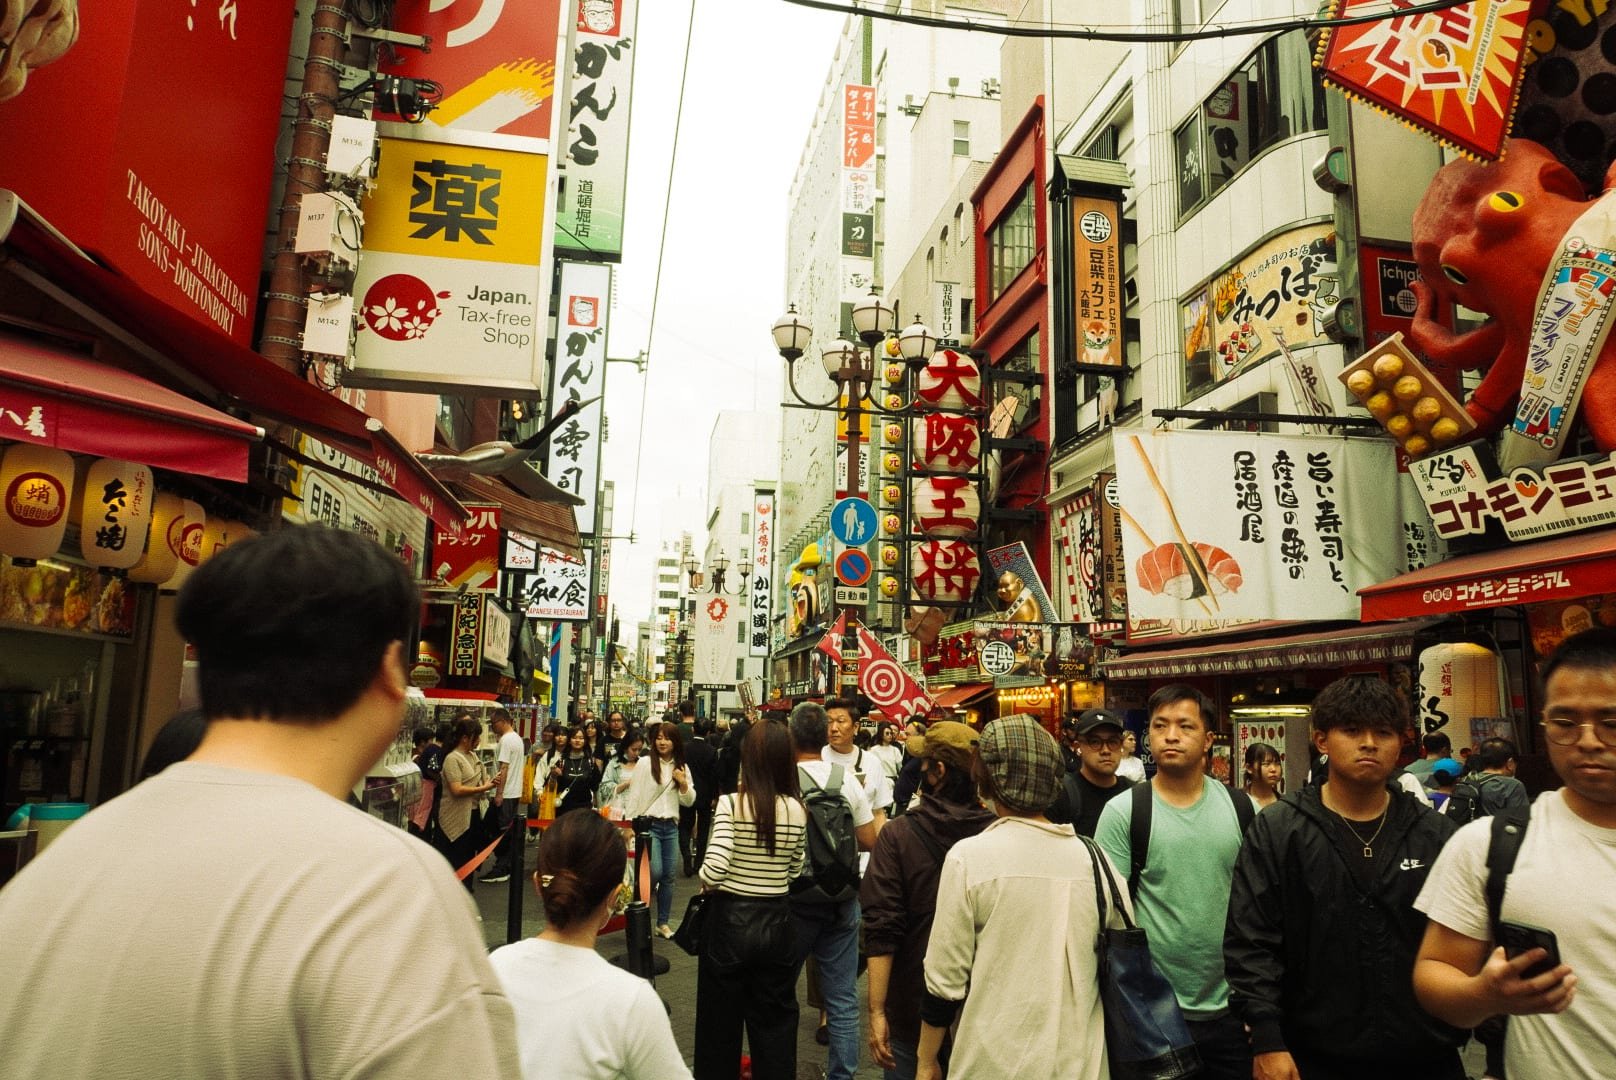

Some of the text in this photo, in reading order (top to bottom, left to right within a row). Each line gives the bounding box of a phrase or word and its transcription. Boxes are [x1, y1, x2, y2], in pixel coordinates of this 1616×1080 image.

[569, 37, 632, 167] がんこ
[341, 137, 364, 147] M136
[307, 213, 326, 222] M137
[409, 159, 502, 246] 薬
[574, 179, 593, 239] 道頓堀店
[467, 285, 532, 306] Japan.
[1089, 248, 1105, 320] 豆柴カフェ
[1107, 245, 1117, 336] MAMESHIBA CAFE
[1233, 256, 1323, 325] みつば
[458, 305, 531, 326] Tax-free
[1080, 290, 1090, 318] 大阪店
[317, 316, 340, 327] M142
[1531, 297, 1577, 375] フライング
[483, 327, 530, 347] Shop
[917, 350, 986, 600] 大阪王将
[1429, 454, 1466, 485] くくる
[1234, 450, 1265, 543] 居酒屋
[1440, 485, 1467, 497] KUKURU
[1272, 450, 1309, 581] 産直の魚の
[1307, 452, 1349, 593] 旨い寿司と、
[1508, 525, 1545, 538] Dotonbori
[1545, 517, 1577, 532] KUKURU
[757, 520, 770, 567] 本場の味
[527, 578, 587, 607] 和食
[837, 590, 868, 601] 自動車
[1456, 571, 1571, 600] コナモンミュージアム
[527, 608, 586, 617] JAPANESE RESTAURANT
